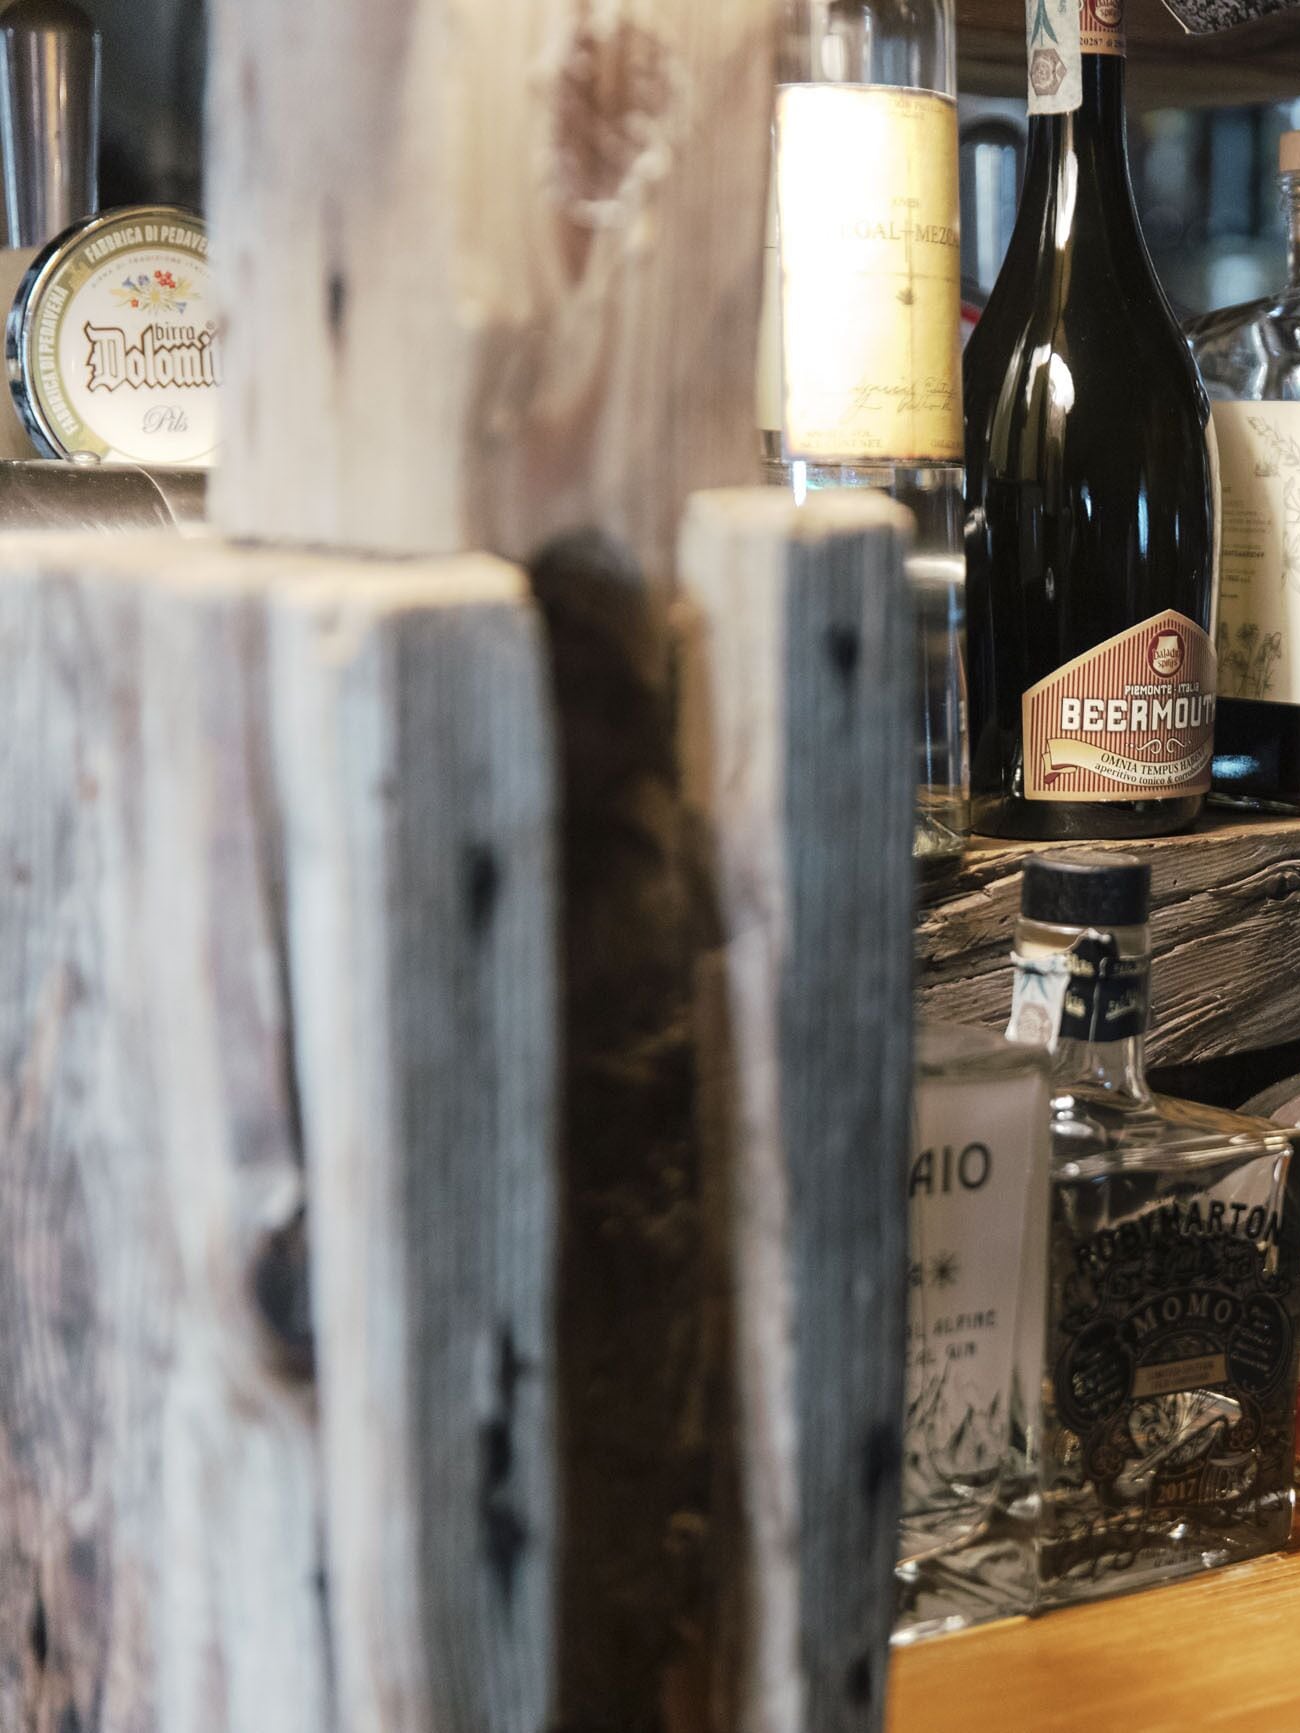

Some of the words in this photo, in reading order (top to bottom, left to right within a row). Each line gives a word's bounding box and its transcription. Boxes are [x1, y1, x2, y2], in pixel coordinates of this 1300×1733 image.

[144, 225, 158, 242] DI
[160, 225, 209, 256] PEDAVE
[38, 284, 69, 354] PEDAVENA
[154, 322, 196, 342] birra
[38, 355, 56, 371] DI
[83, 320, 223, 394] Dolomit
[141, 404, 189, 434] Pils
[1094, 763, 1137, 783] aperitivo
[1100, 752, 1138, 774] OMNIA
[1141, 760, 1180, 775] TEMPUS
[908, 1142, 992, 1198] AIO
[1134, 1293, 1233, 1336] MOMO
